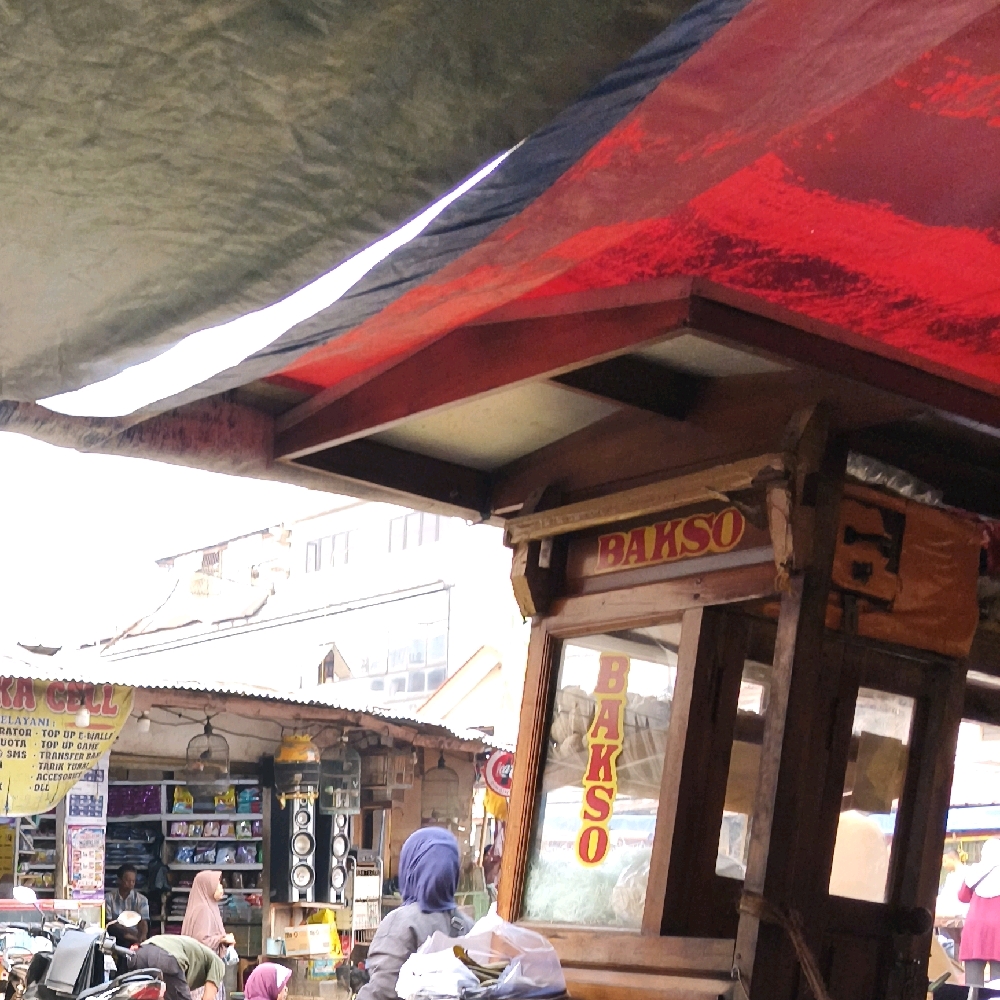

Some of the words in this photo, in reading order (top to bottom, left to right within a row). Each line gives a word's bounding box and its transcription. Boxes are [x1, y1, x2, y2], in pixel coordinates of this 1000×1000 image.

[595, 508, 745, 573] BAKSO
[46, 681, 119, 716] CELL
[41, 729, 60, 738] TOP
[63, 729, 76, 739] UP
[40, 740, 59, 749] TOP
[62, 740, 74, 750] UP
[6, 749, 27, 759] SMS
[39, 751, 84, 760] TRANSFER
[575, 652, 629, 868] BAKSO
